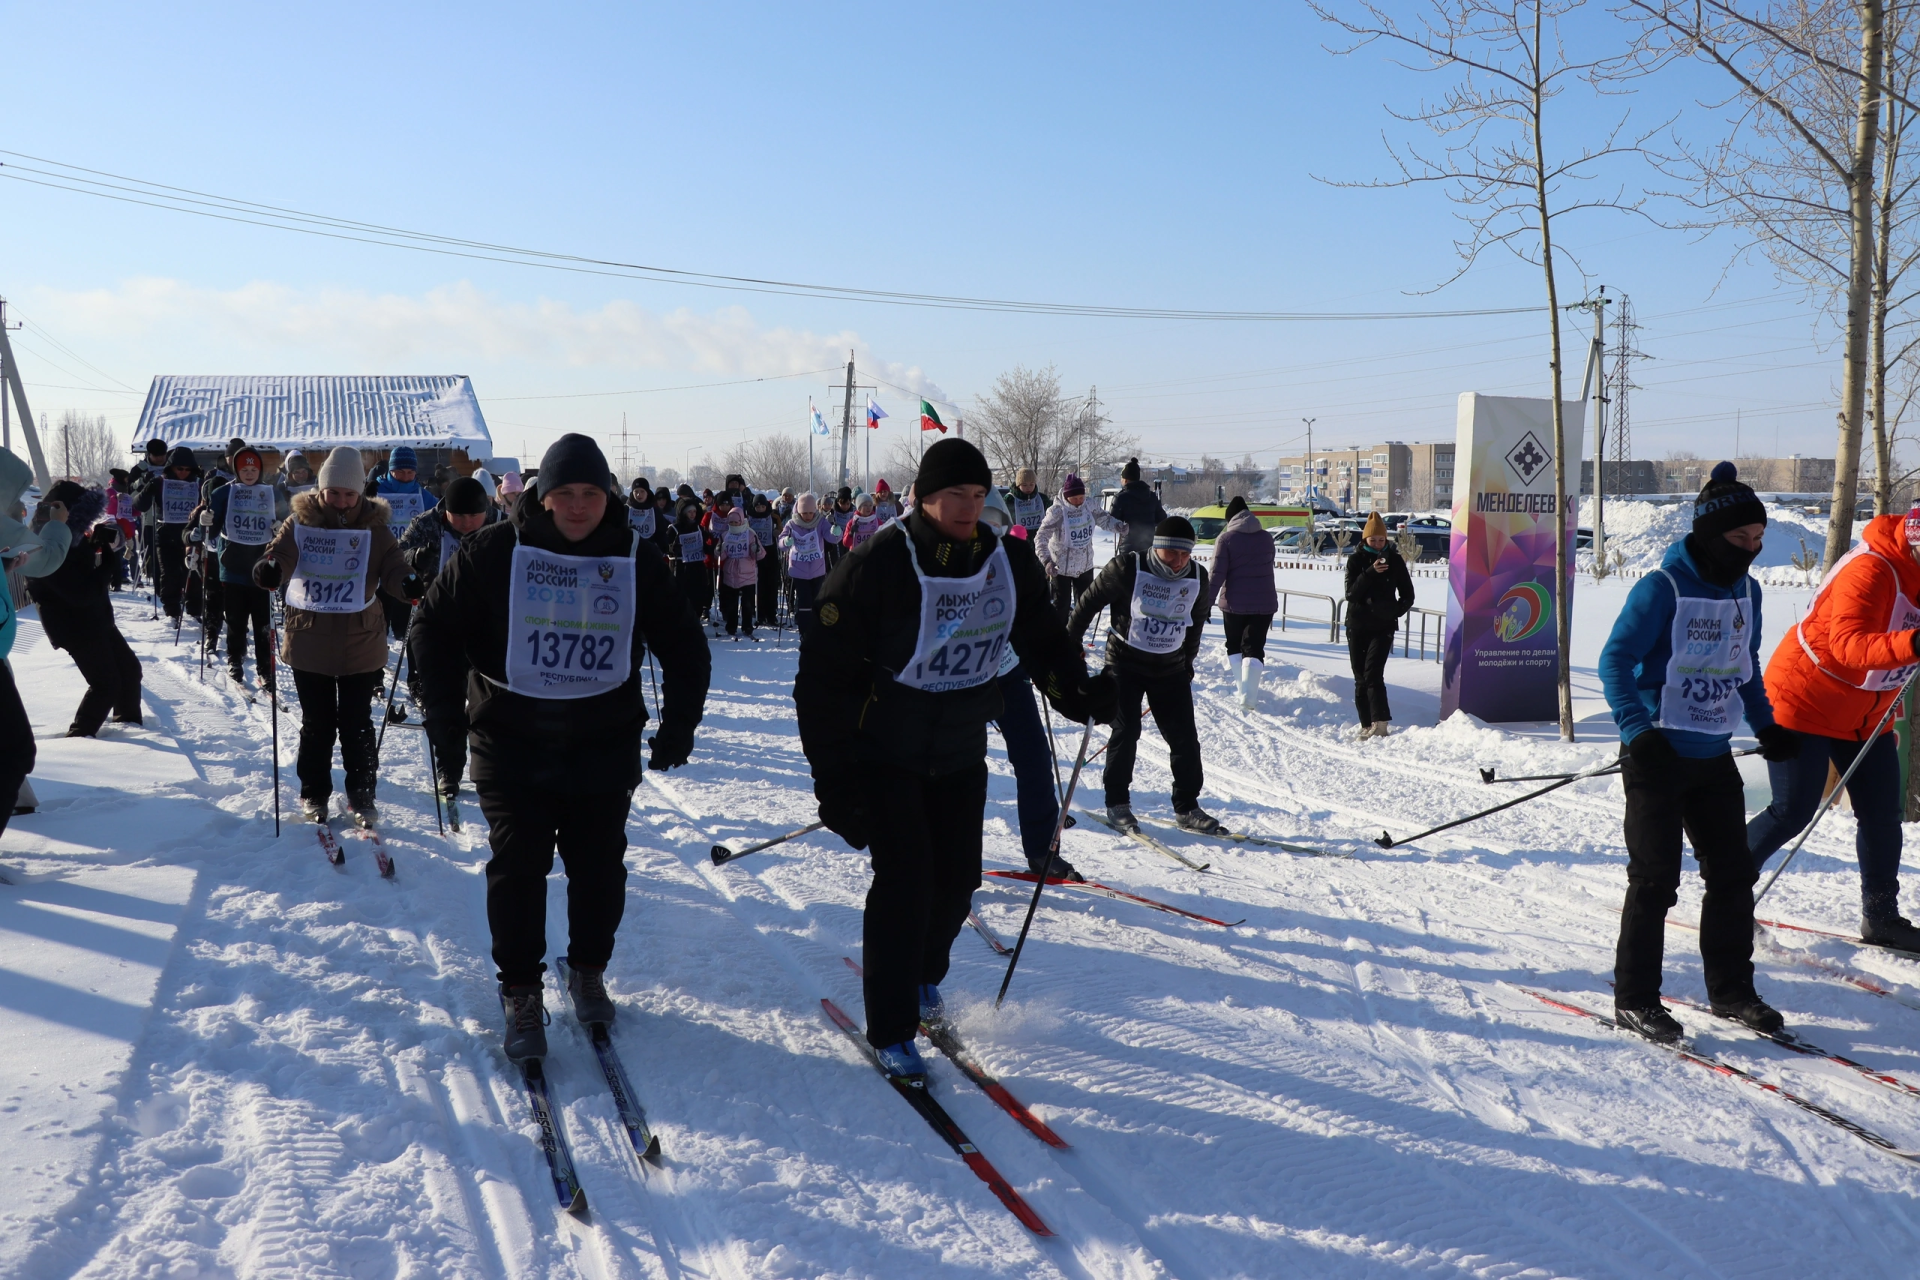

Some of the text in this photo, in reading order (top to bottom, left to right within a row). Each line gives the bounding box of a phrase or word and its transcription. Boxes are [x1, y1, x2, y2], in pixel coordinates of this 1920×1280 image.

[165, 500, 196, 512] 14429
[1477, 492, 1573, 514] МЕНДЕЛЕЕВК
[233, 515, 266, 531] 9416
[1021, 515, 1041, 526] 9372
[1070, 525, 1092, 540] 9486
[304, 536, 336, 546] ЛЫЖНЯ
[303, 543, 335, 555] РОССИИ
[302, 553, 333, 565] 2023
[526, 559, 577, 576] ЛЫЖНЯ
[527, 571, 578, 588] РОССИИ
[302, 579, 355, 604] 13112
[526, 586, 576, 605] 2023
[1142, 583, 1171, 594] ЛЫЖНЯ
[1142, 589, 1170, 601] РОССИИ
[935, 591, 981, 607] ЛЫЖН
[936, 607, 970, 621] РОСС
[525, 616, 620, 632] СПОРТ НОРМА ЖИЗНИ
[980, 620, 1007, 635] ЖИЗНИ
[1686, 618, 1722, 630] ЛЫЖНЯ
[1687, 629, 1722, 641] РОССИИ
[527, 629, 615, 671] 13782
[1474, 649, 1520, 658] Управление
[1478, 659, 1517, 667] молодёжи
[1525, 659, 1551, 667] спорту
[921, 671, 989, 692] РЕСПУБЛИКА
